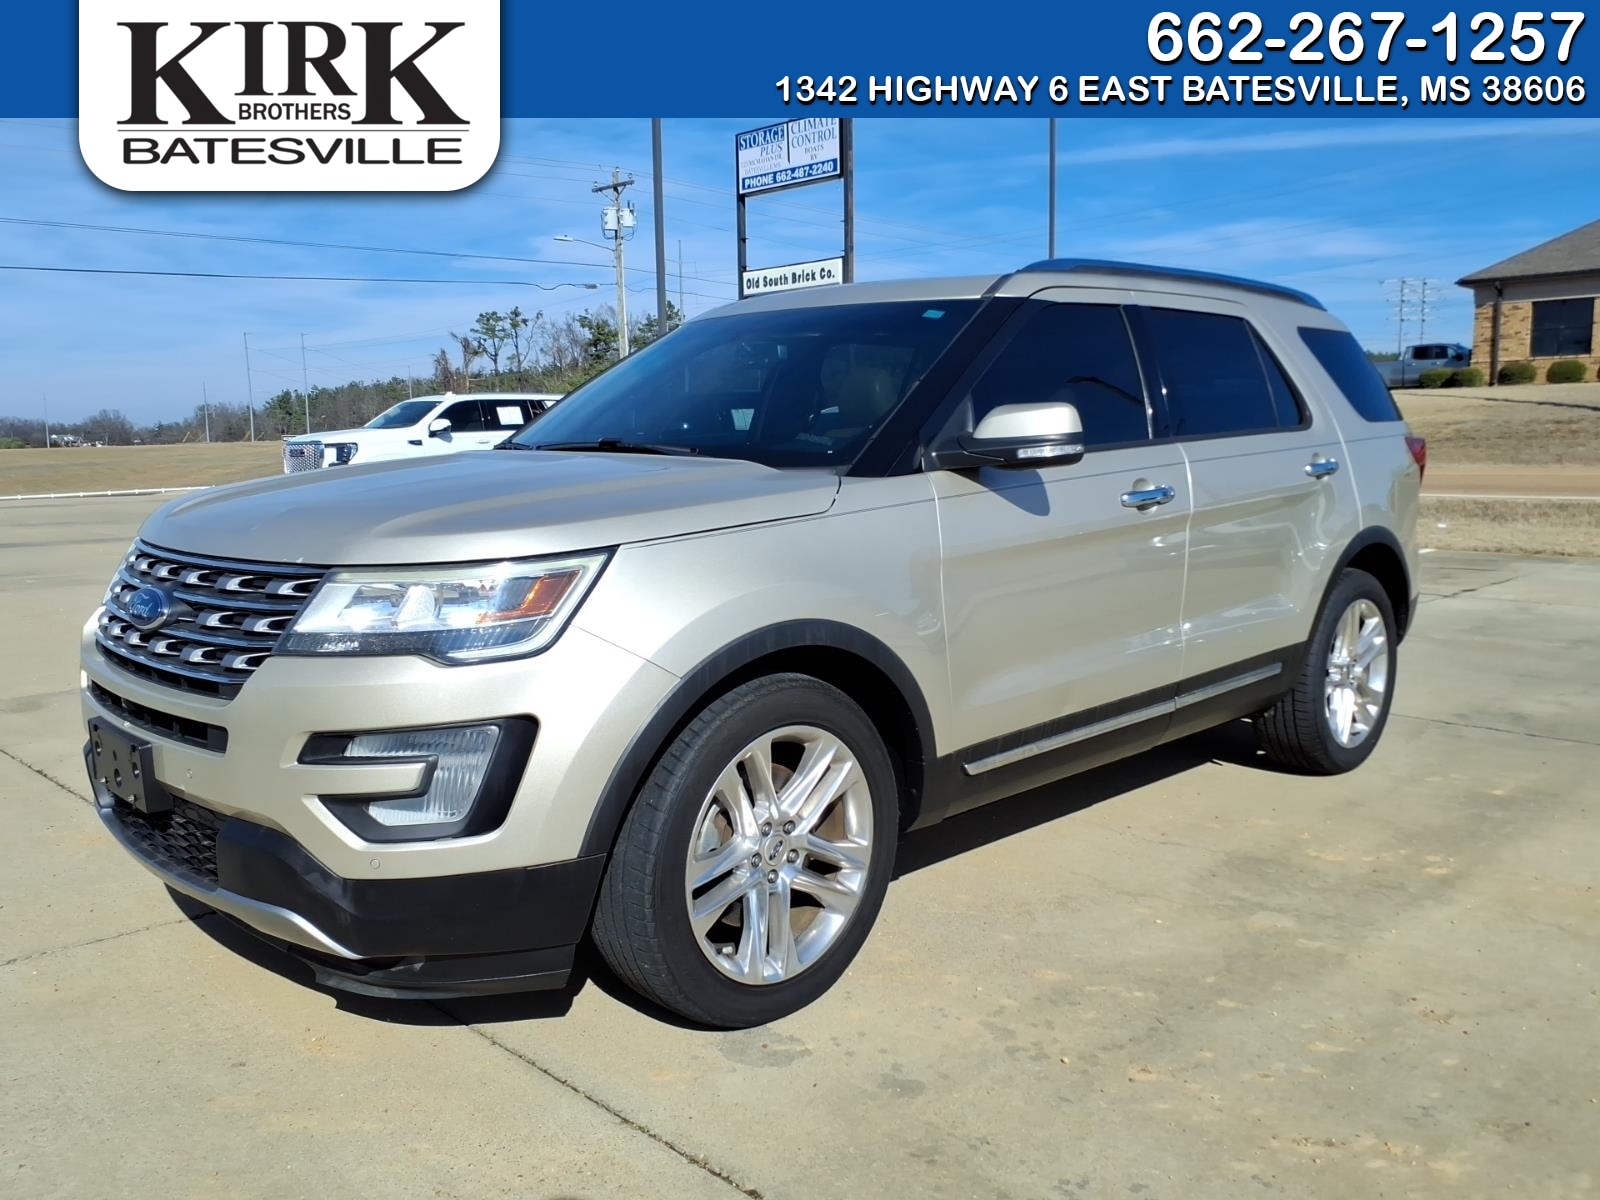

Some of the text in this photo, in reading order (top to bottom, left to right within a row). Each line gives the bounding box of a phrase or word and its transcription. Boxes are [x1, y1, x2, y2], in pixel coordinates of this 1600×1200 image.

[740, 126, 785, 150] STORAGE
[791, 127, 837, 149] CONTROL
[760, 143, 783, 157] PLUS
[744, 174, 774, 189] PHONE
[775, 161, 834, 182] 662-487-2240
[746, 267, 836, 290] Old South Brick Co.
